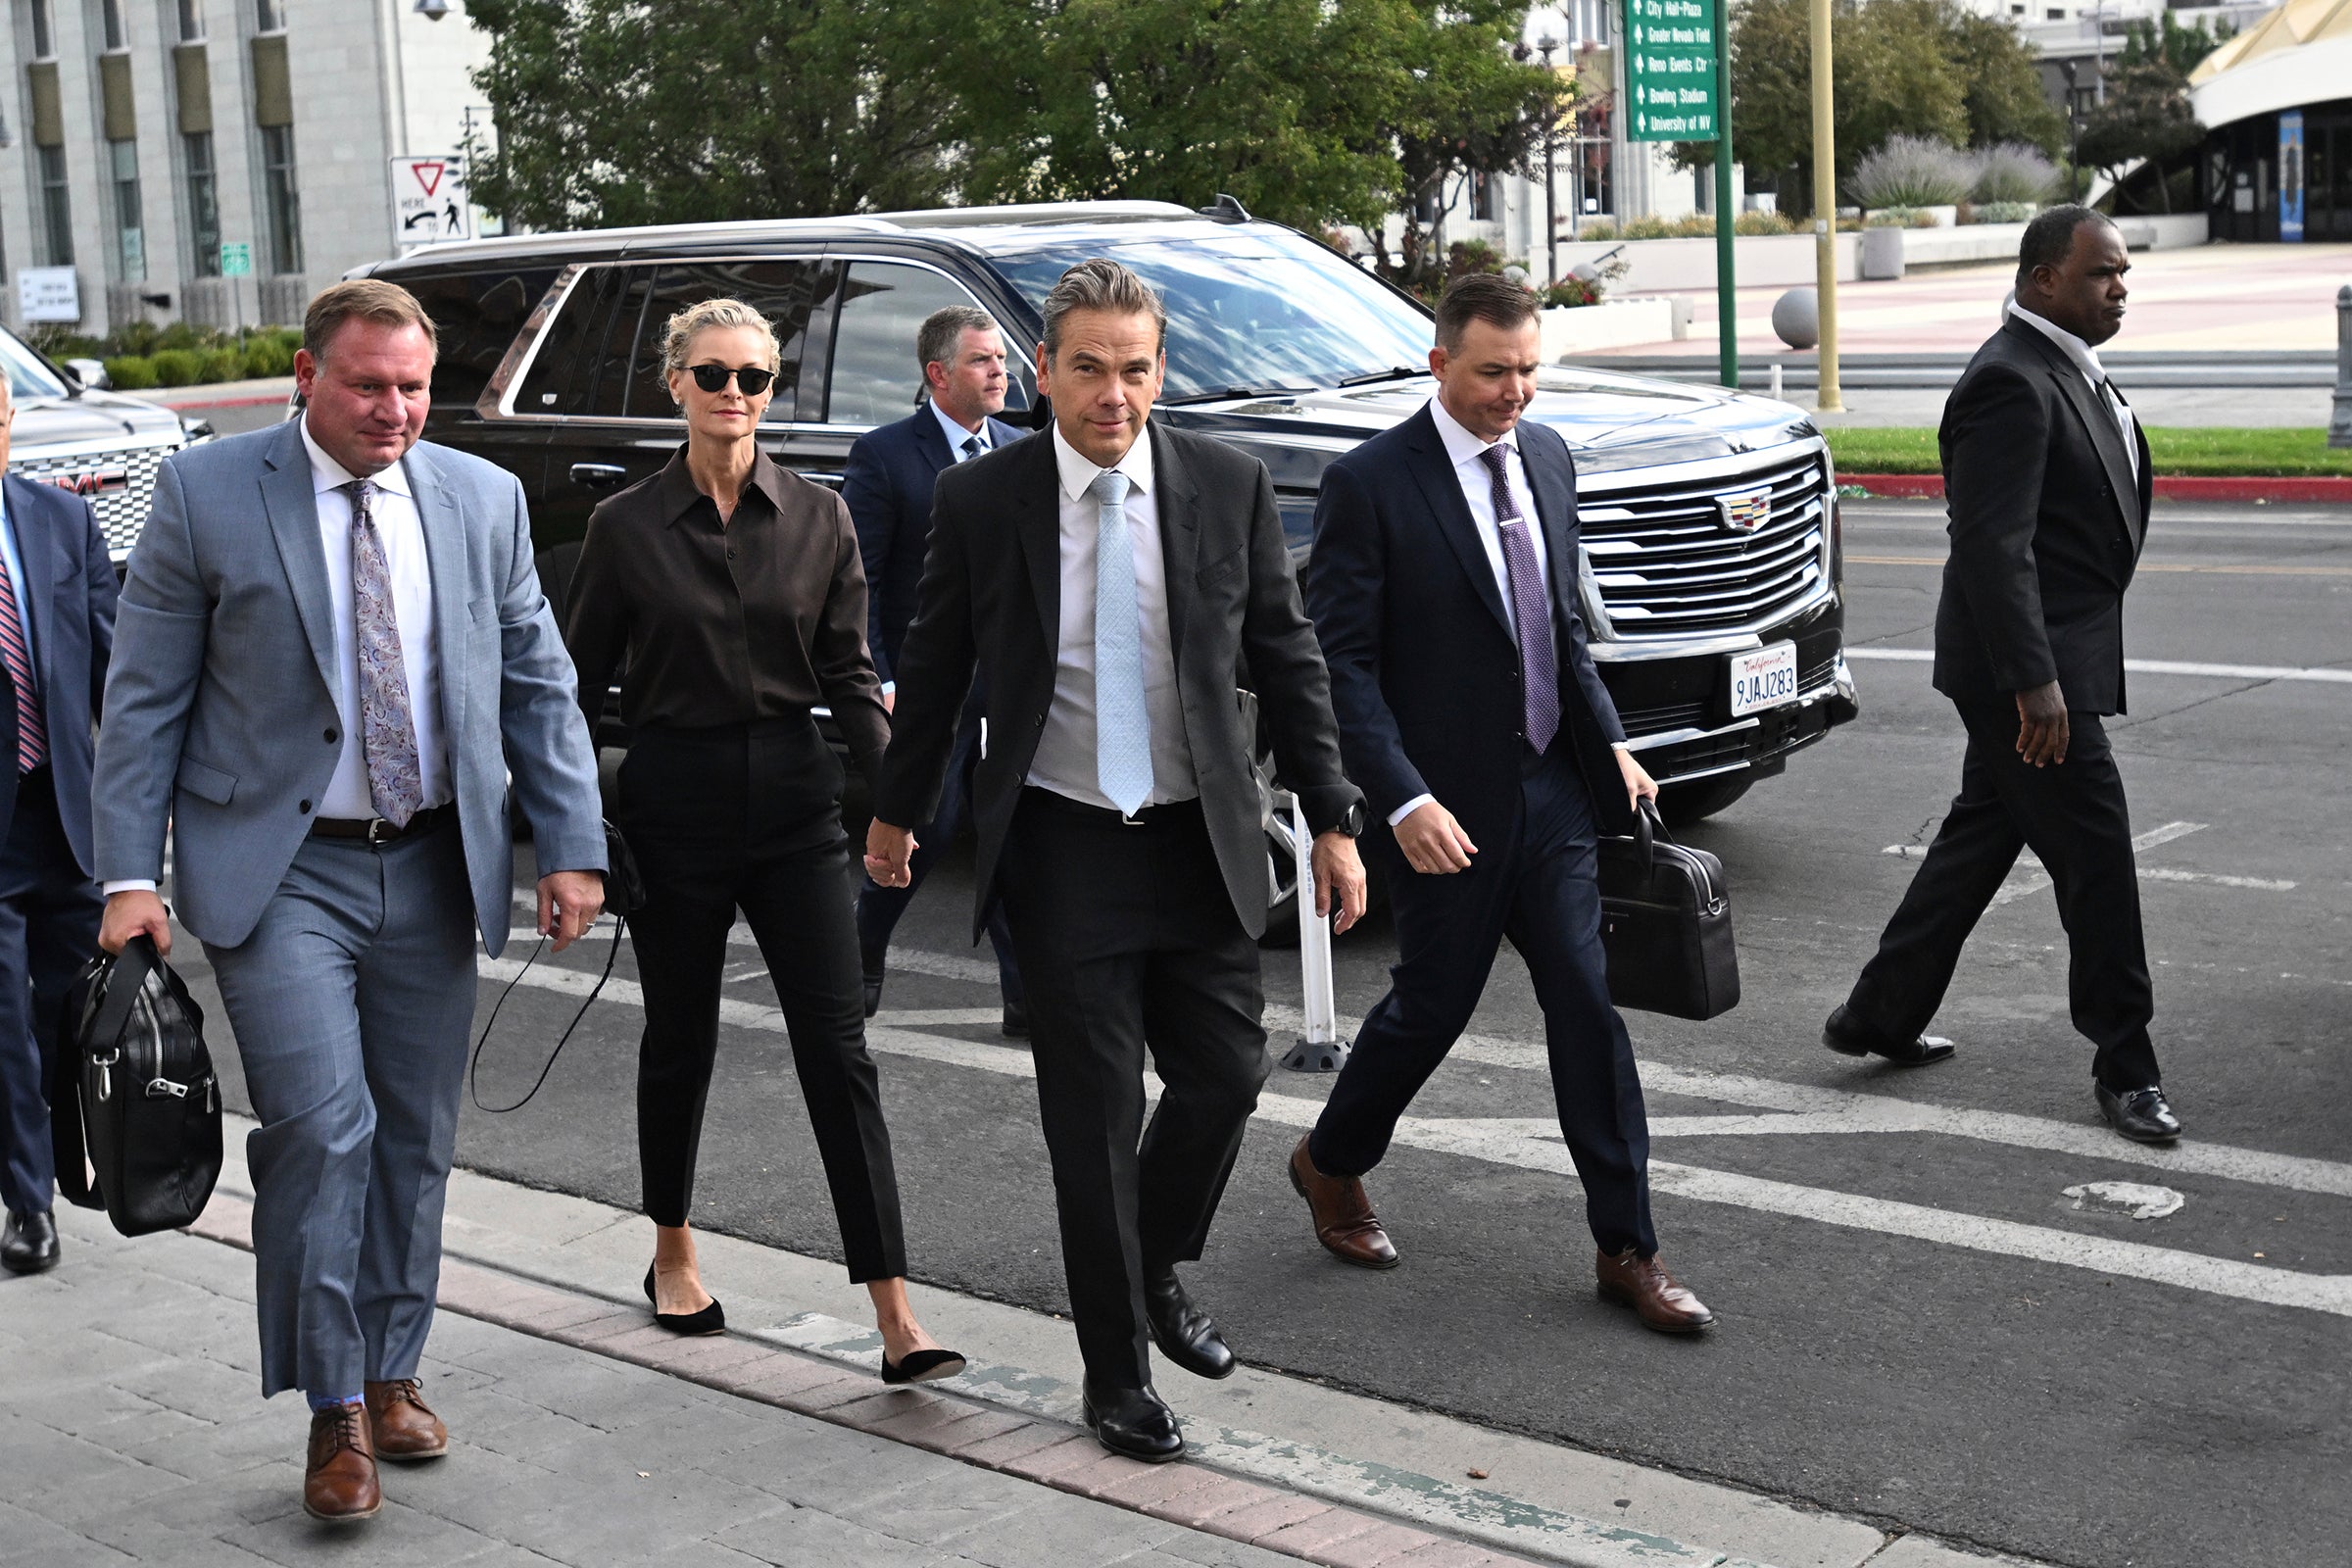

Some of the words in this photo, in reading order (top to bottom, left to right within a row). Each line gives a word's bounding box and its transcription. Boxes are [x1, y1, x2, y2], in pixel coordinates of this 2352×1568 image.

[1646, 1, 1662, 20] City
[1647, 26, 1671, 43] Greater
[1673, 27, 1694, 43] Nevada
[1696, 27, 1711, 44] Field
[1648, 57, 1667, 73] Reno
[1669, 57, 1693, 74] Events
[1696, 57, 1707, 73] Ctr
[1649, 88, 1677, 109] Bowling
[1679, 87, 1708, 104] Stadium
[1651, 116, 1687, 133] University
[1690, 116, 1696, 130] of
[1699, 116, 1711, 130] NV
[34, 469, 127, 496] MC
[1745, 657, 1784, 672] California
[1737, 667, 1793, 707] 9JAJ283
